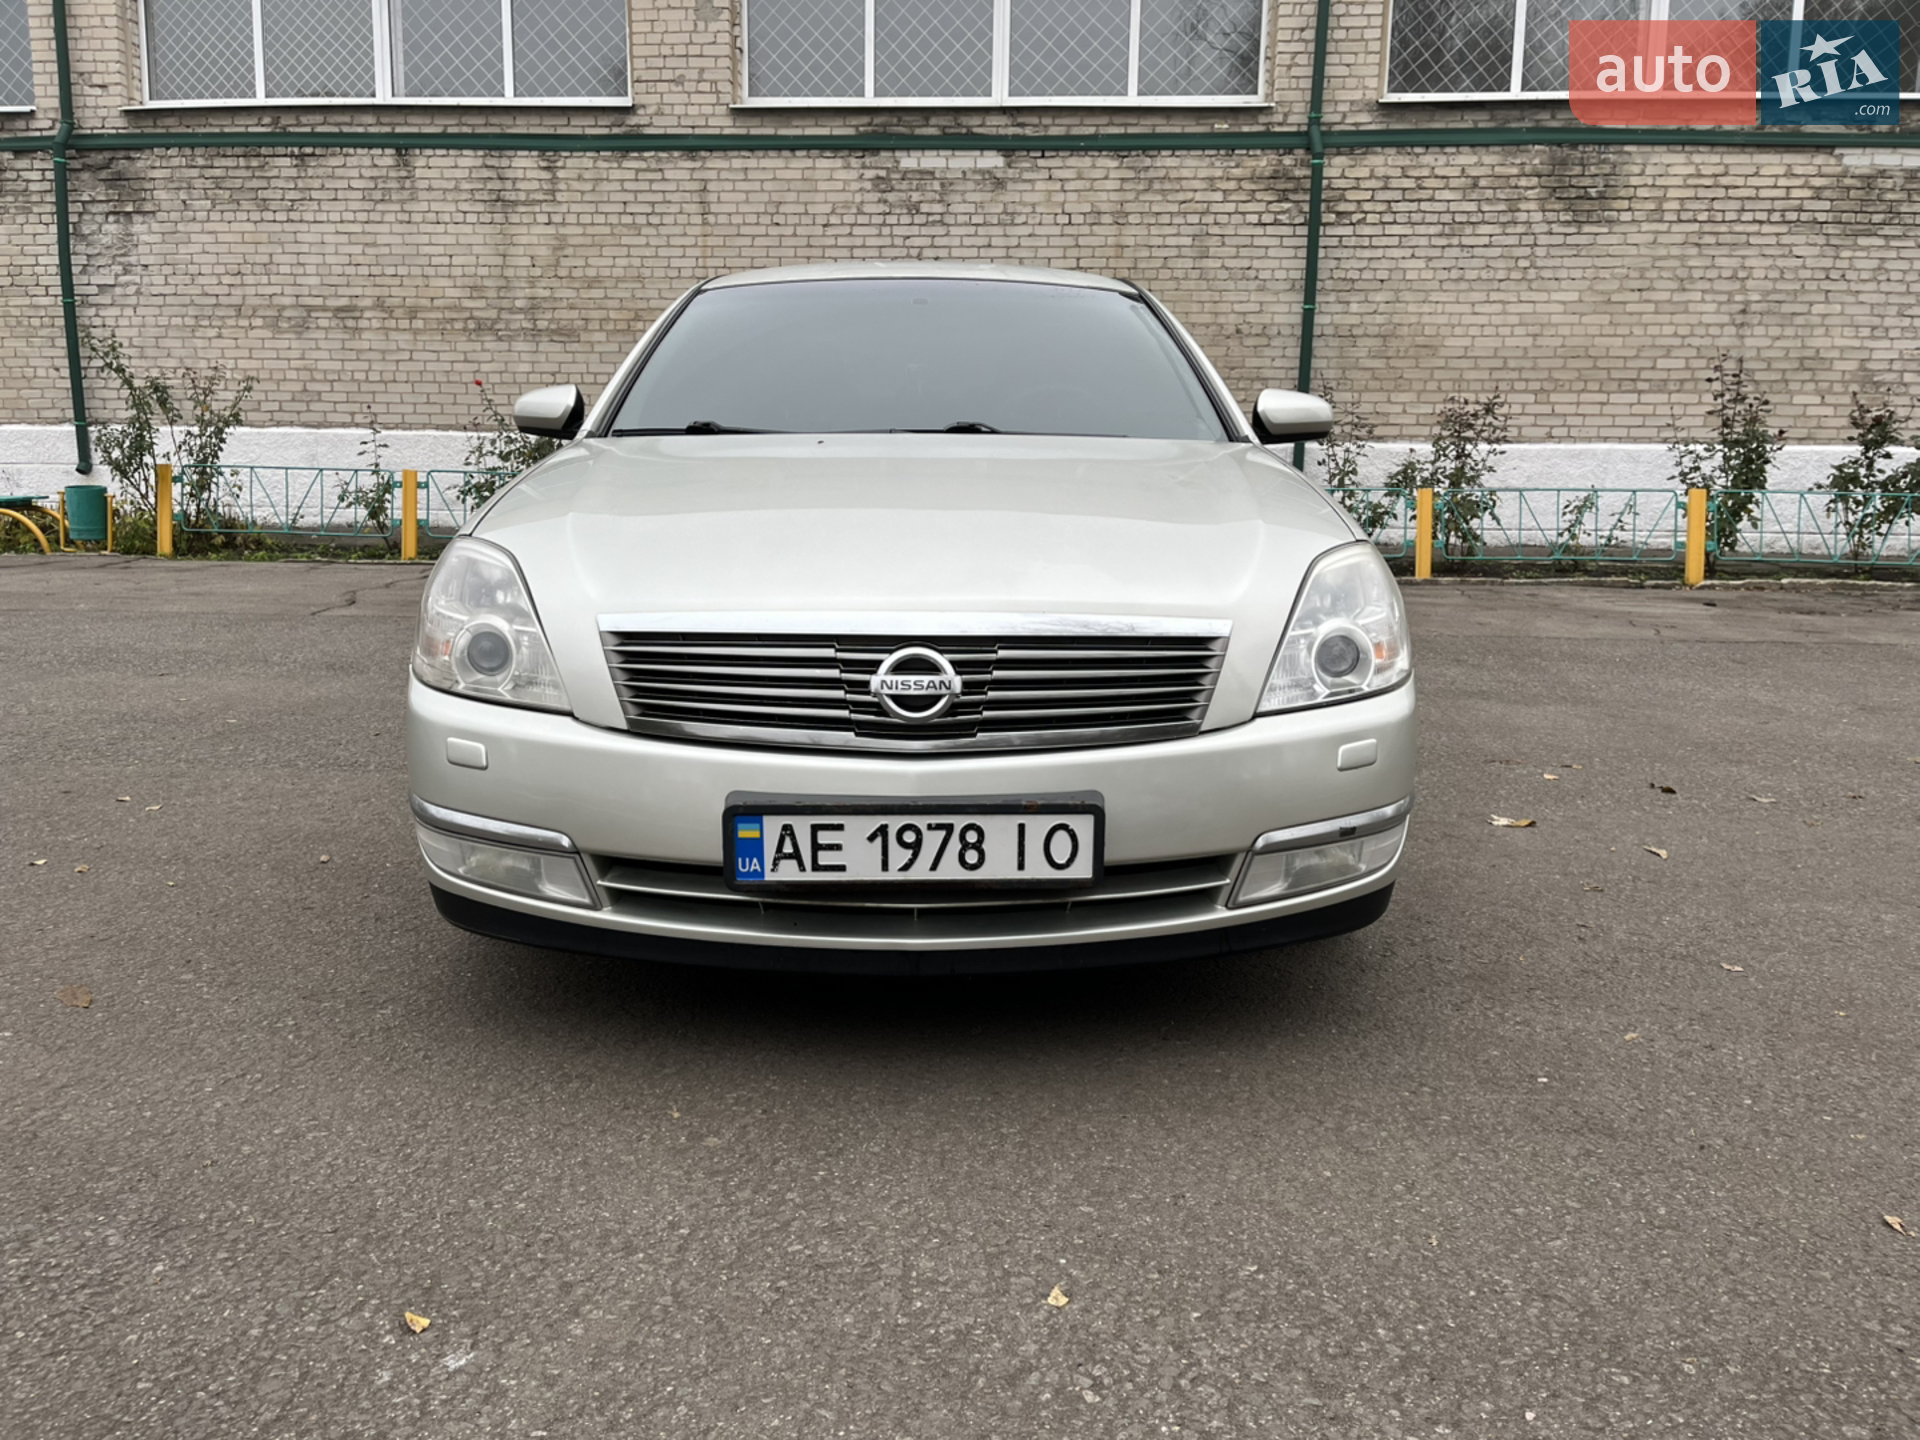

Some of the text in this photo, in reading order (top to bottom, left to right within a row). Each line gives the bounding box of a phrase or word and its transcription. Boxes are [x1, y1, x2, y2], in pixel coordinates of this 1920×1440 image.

[880, 679, 952, 691] NISSAN
[770, 822, 1080, 873] AE 1978 IO
[737, 856, 762, 873] UA
